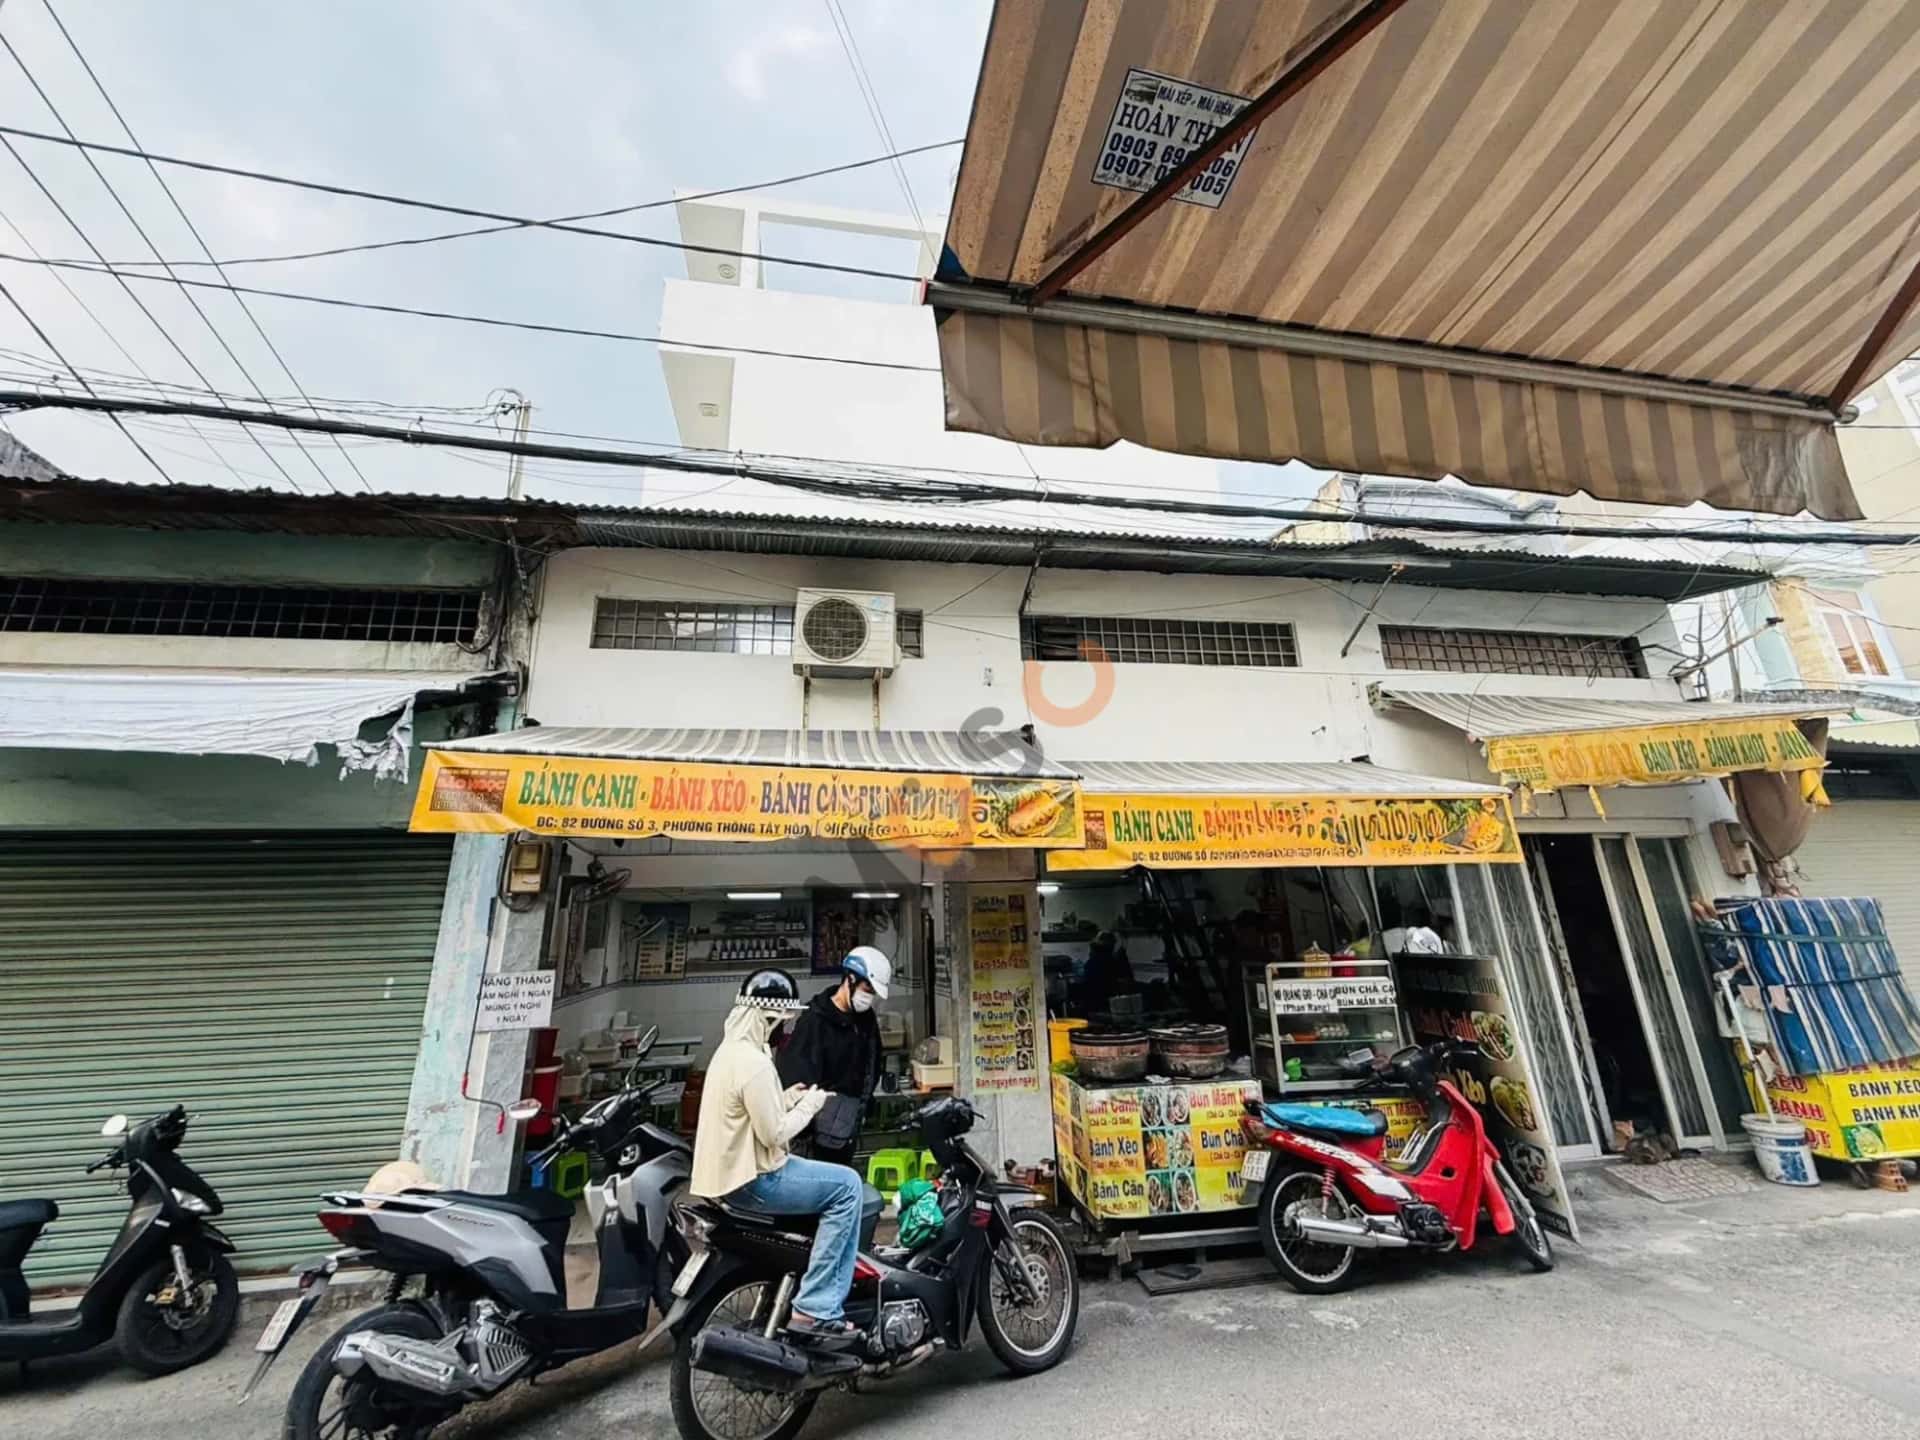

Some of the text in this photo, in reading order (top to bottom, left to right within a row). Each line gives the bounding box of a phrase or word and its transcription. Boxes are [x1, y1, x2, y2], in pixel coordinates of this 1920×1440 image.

[1109, 132, 1158, 159] 0903
[1102, 152, 1152, 178] 0907
[518, 760, 580, 806] BÁNH
[581, 772, 639, 809] CANH
[650, 767, 706, 811] BÁNH
[759, 771, 812, 815] BÁNH
[1112, 799, 1153, 842] BÁNH
[1156, 809, 1196, 842] CANH
